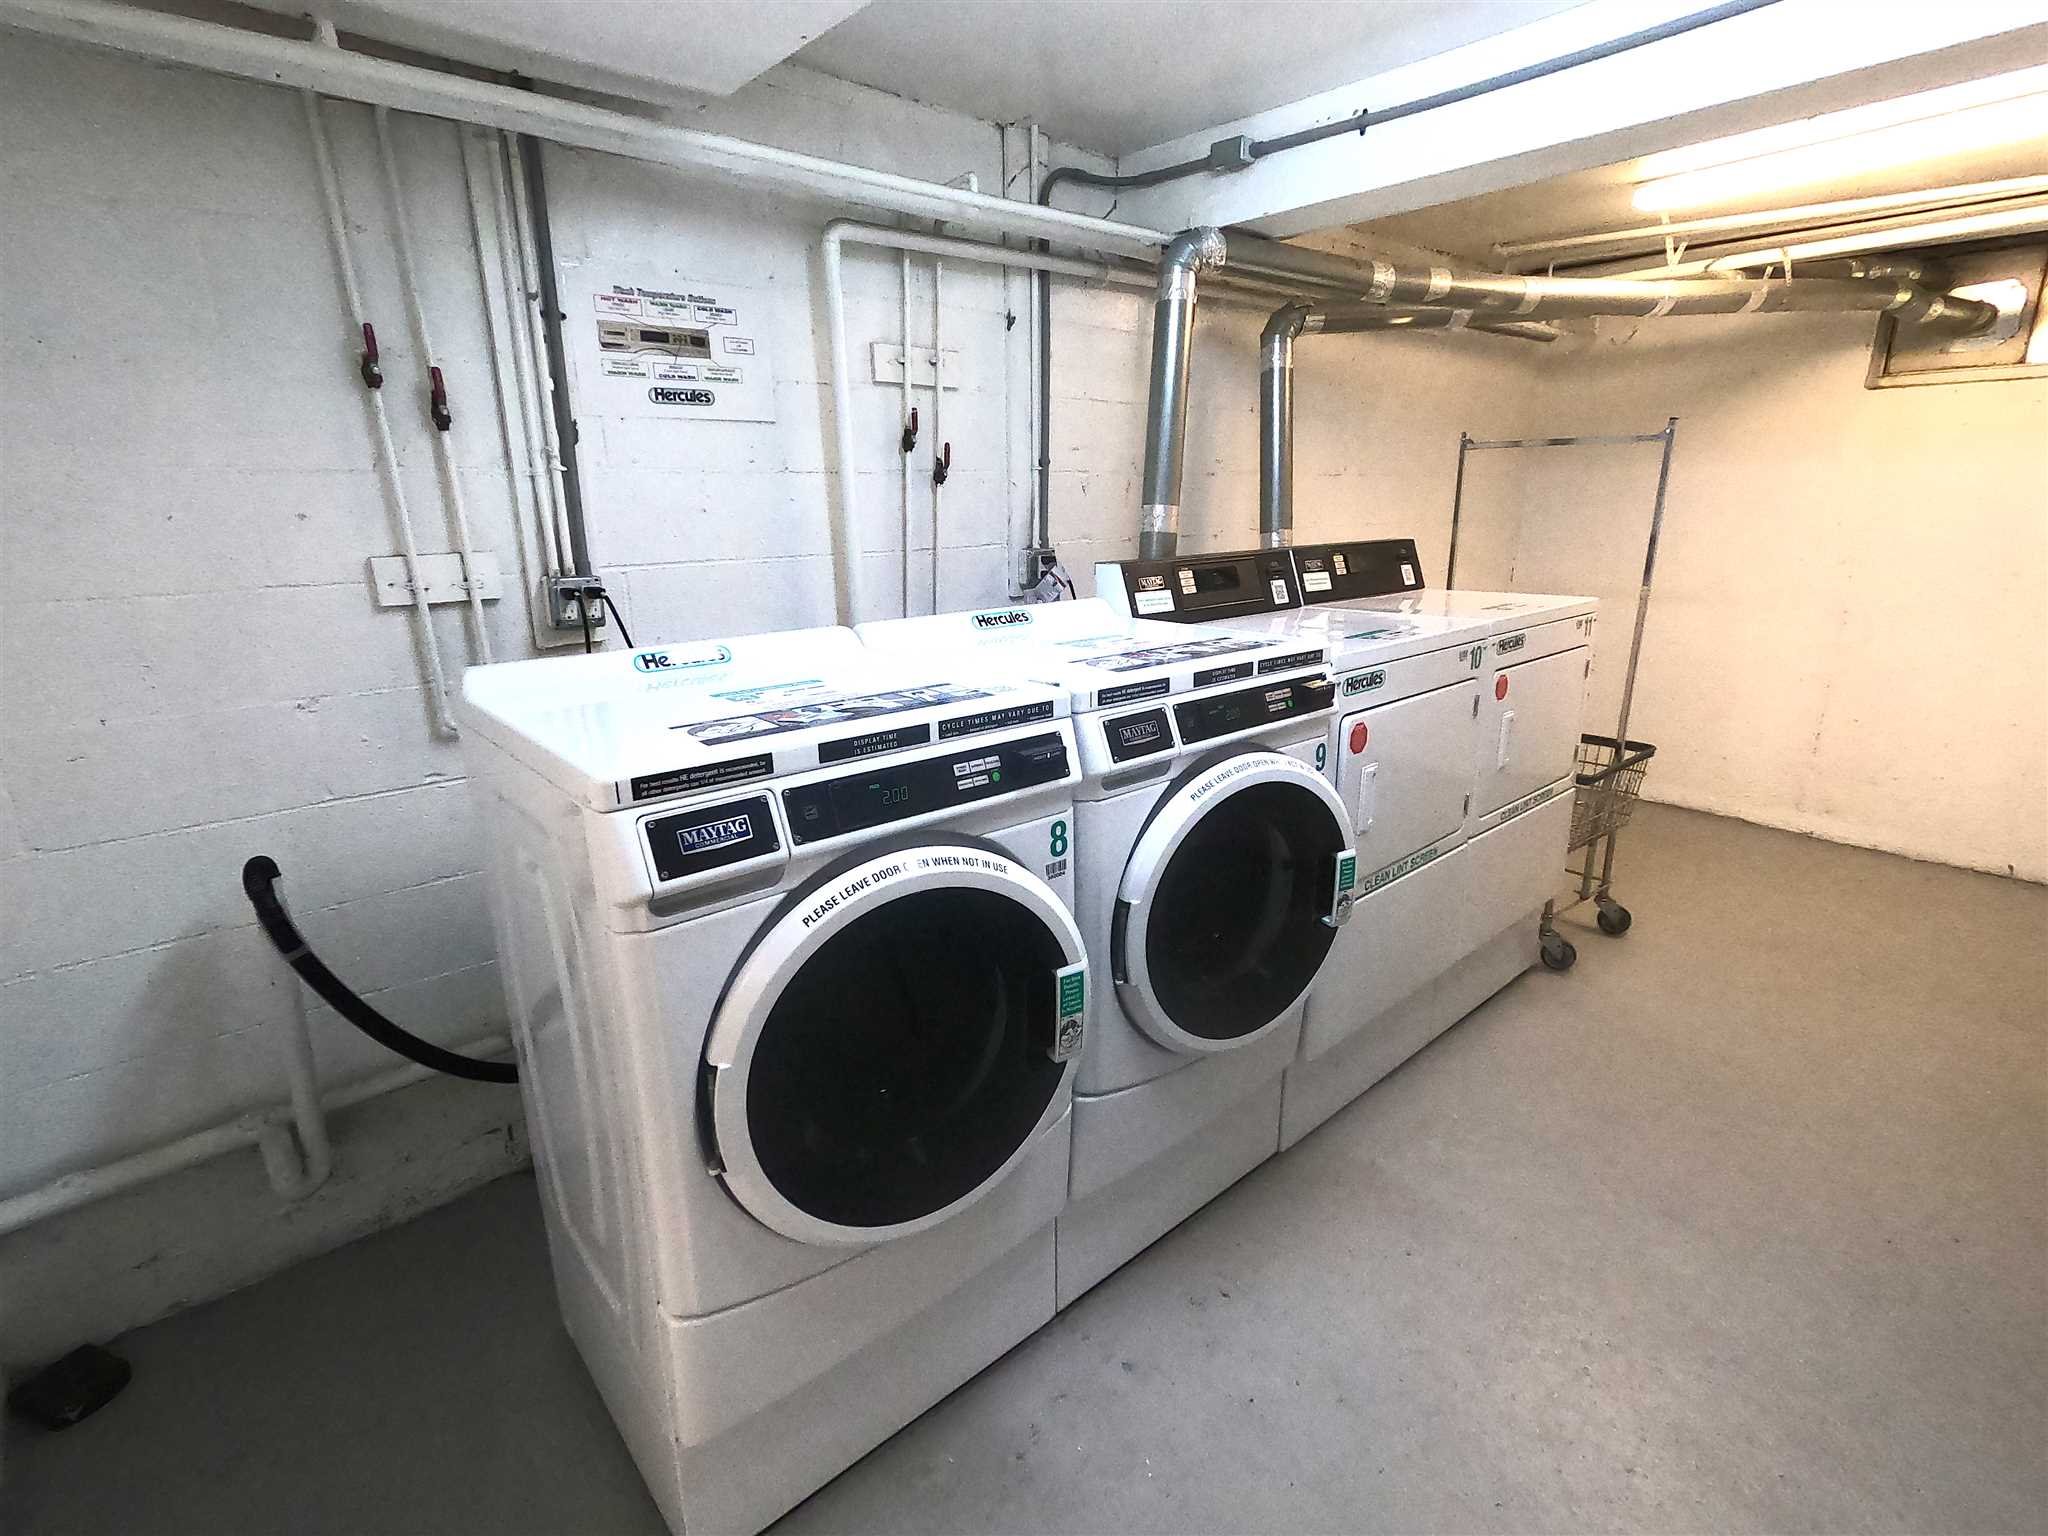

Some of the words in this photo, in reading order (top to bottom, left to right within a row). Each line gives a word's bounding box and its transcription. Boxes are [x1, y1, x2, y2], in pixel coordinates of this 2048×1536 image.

[654, 387, 712, 404] Hercules
[976, 611, 1029, 628] Hercules
[1469, 645, 1482, 670] 10
[1346, 671, 1384, 692] Hercules
[942, 721, 964, 731] CYCLE
[967, 716, 989, 726] TIMES
[991, 713, 1006, 721] MAY
[1007, 709, 1025, 718] VARY
[1027, 706, 1039, 715] DUE
[1042, 704, 1050, 712] TO
[853, 736, 880, 747] DISPLAY
[882, 732, 897, 741] TIME
[1123, 723, 1157, 740] MAYTAG
[863, 741, 898, 754] ESTIMATED
[1315, 743, 1327, 772] 9
[680, 773, 689, 781] HE
[690, 768, 719, 780] detergent
[1190, 782, 1215, 802] PLEASE
[1215, 769, 1234, 785] LEAVE
[1234, 761, 1252, 774] DOOR
[1253, 758, 1269, 768] OPEN
[882, 785, 909, 805] 2.00
[1500, 803, 1520, 821] CLEAN
[1519, 797, 1533, 812] LINT
[681, 819, 747, 846] MAYTAG
[694, 834, 738, 848] COMMERCIAL
[1050, 820, 1068, 857] 8
[1364, 869, 1391, 892] CLEAN
[1391, 860, 1410, 878] LINT
[801, 895, 841, 929] PLEASE
[840, 875, 873, 902] LEAVE
[872, 864, 903, 884] DOOR
[931, 855, 961, 868] WHEN
[961, 856, 980, 868] NOT
[982, 859, 992, 870] IN
[992, 861, 1009, 875] USE
